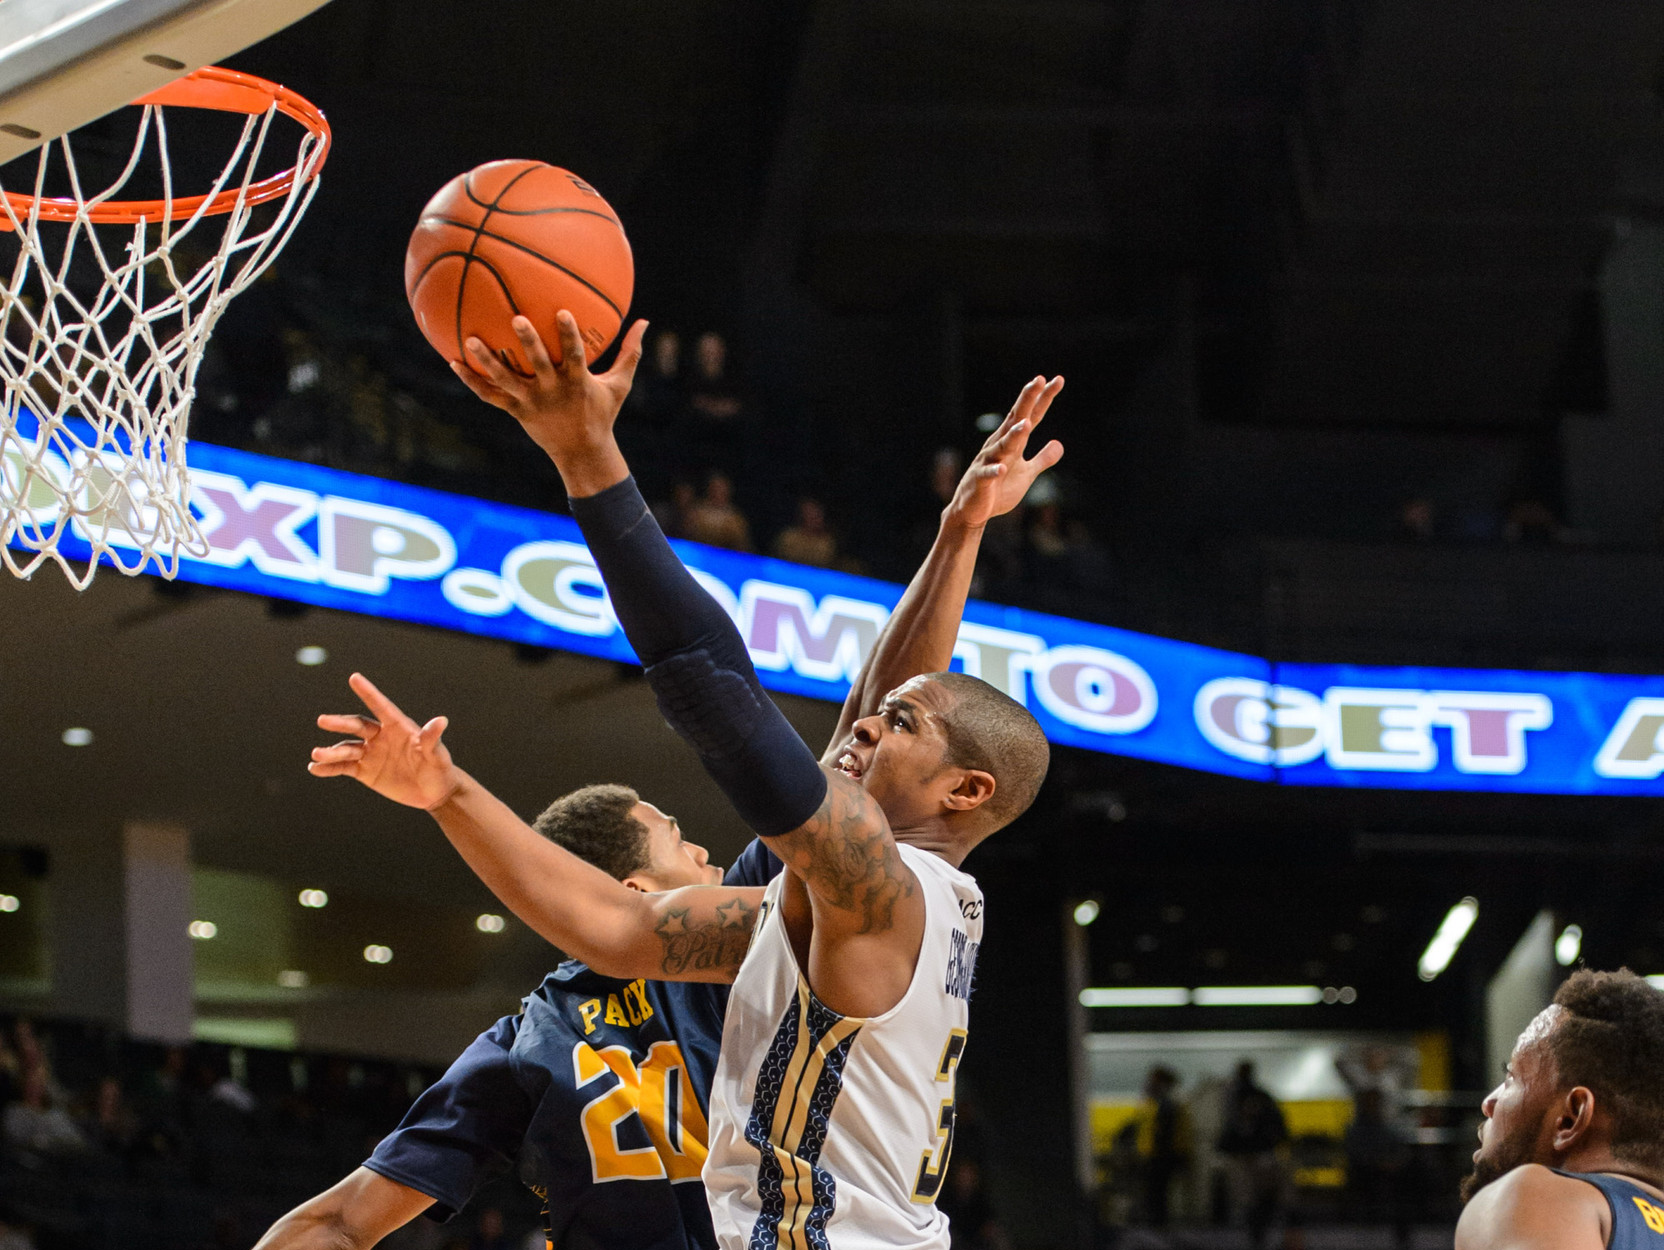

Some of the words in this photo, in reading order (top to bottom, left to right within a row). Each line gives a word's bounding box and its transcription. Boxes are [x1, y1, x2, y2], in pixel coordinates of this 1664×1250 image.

[952, 620, 1158, 734] TO
[1194, 677, 1553, 774] GET
[578, 979, 654, 1036] PACK
[573, 1041, 709, 1184] 20
[1632, 1196, 1664, 1234] B
